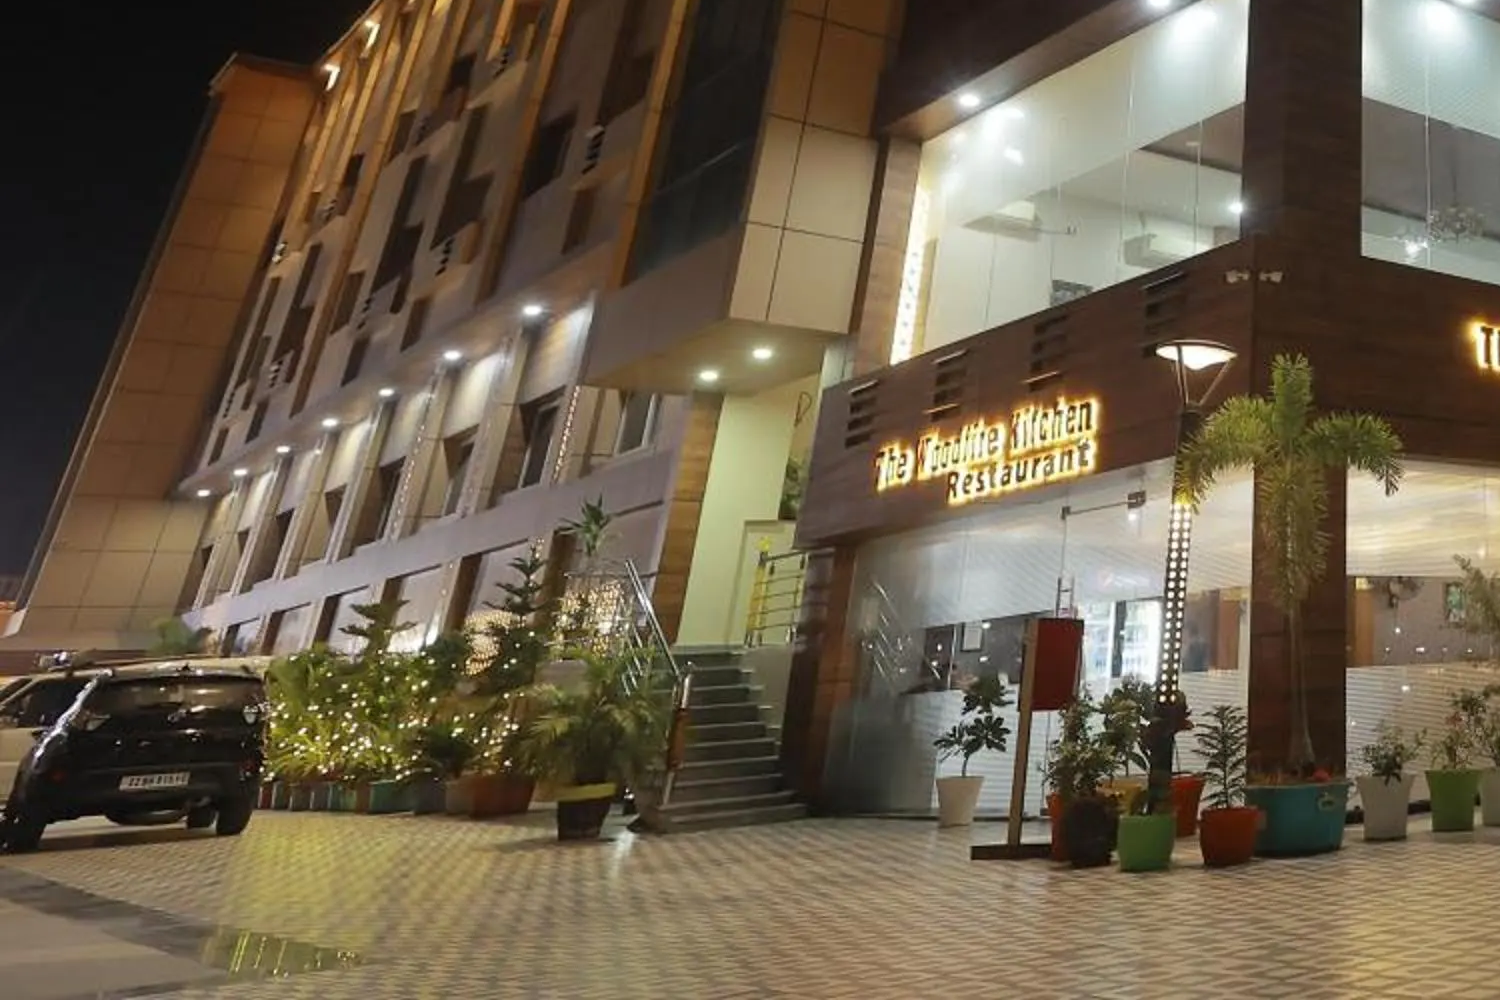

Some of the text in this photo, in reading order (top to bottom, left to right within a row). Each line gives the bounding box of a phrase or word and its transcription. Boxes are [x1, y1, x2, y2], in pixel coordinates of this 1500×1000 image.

[875, 443, 911, 488] The
[1011, 398, 1095, 450] Kitchen
[947, 438, 1093, 500] Restaurant
